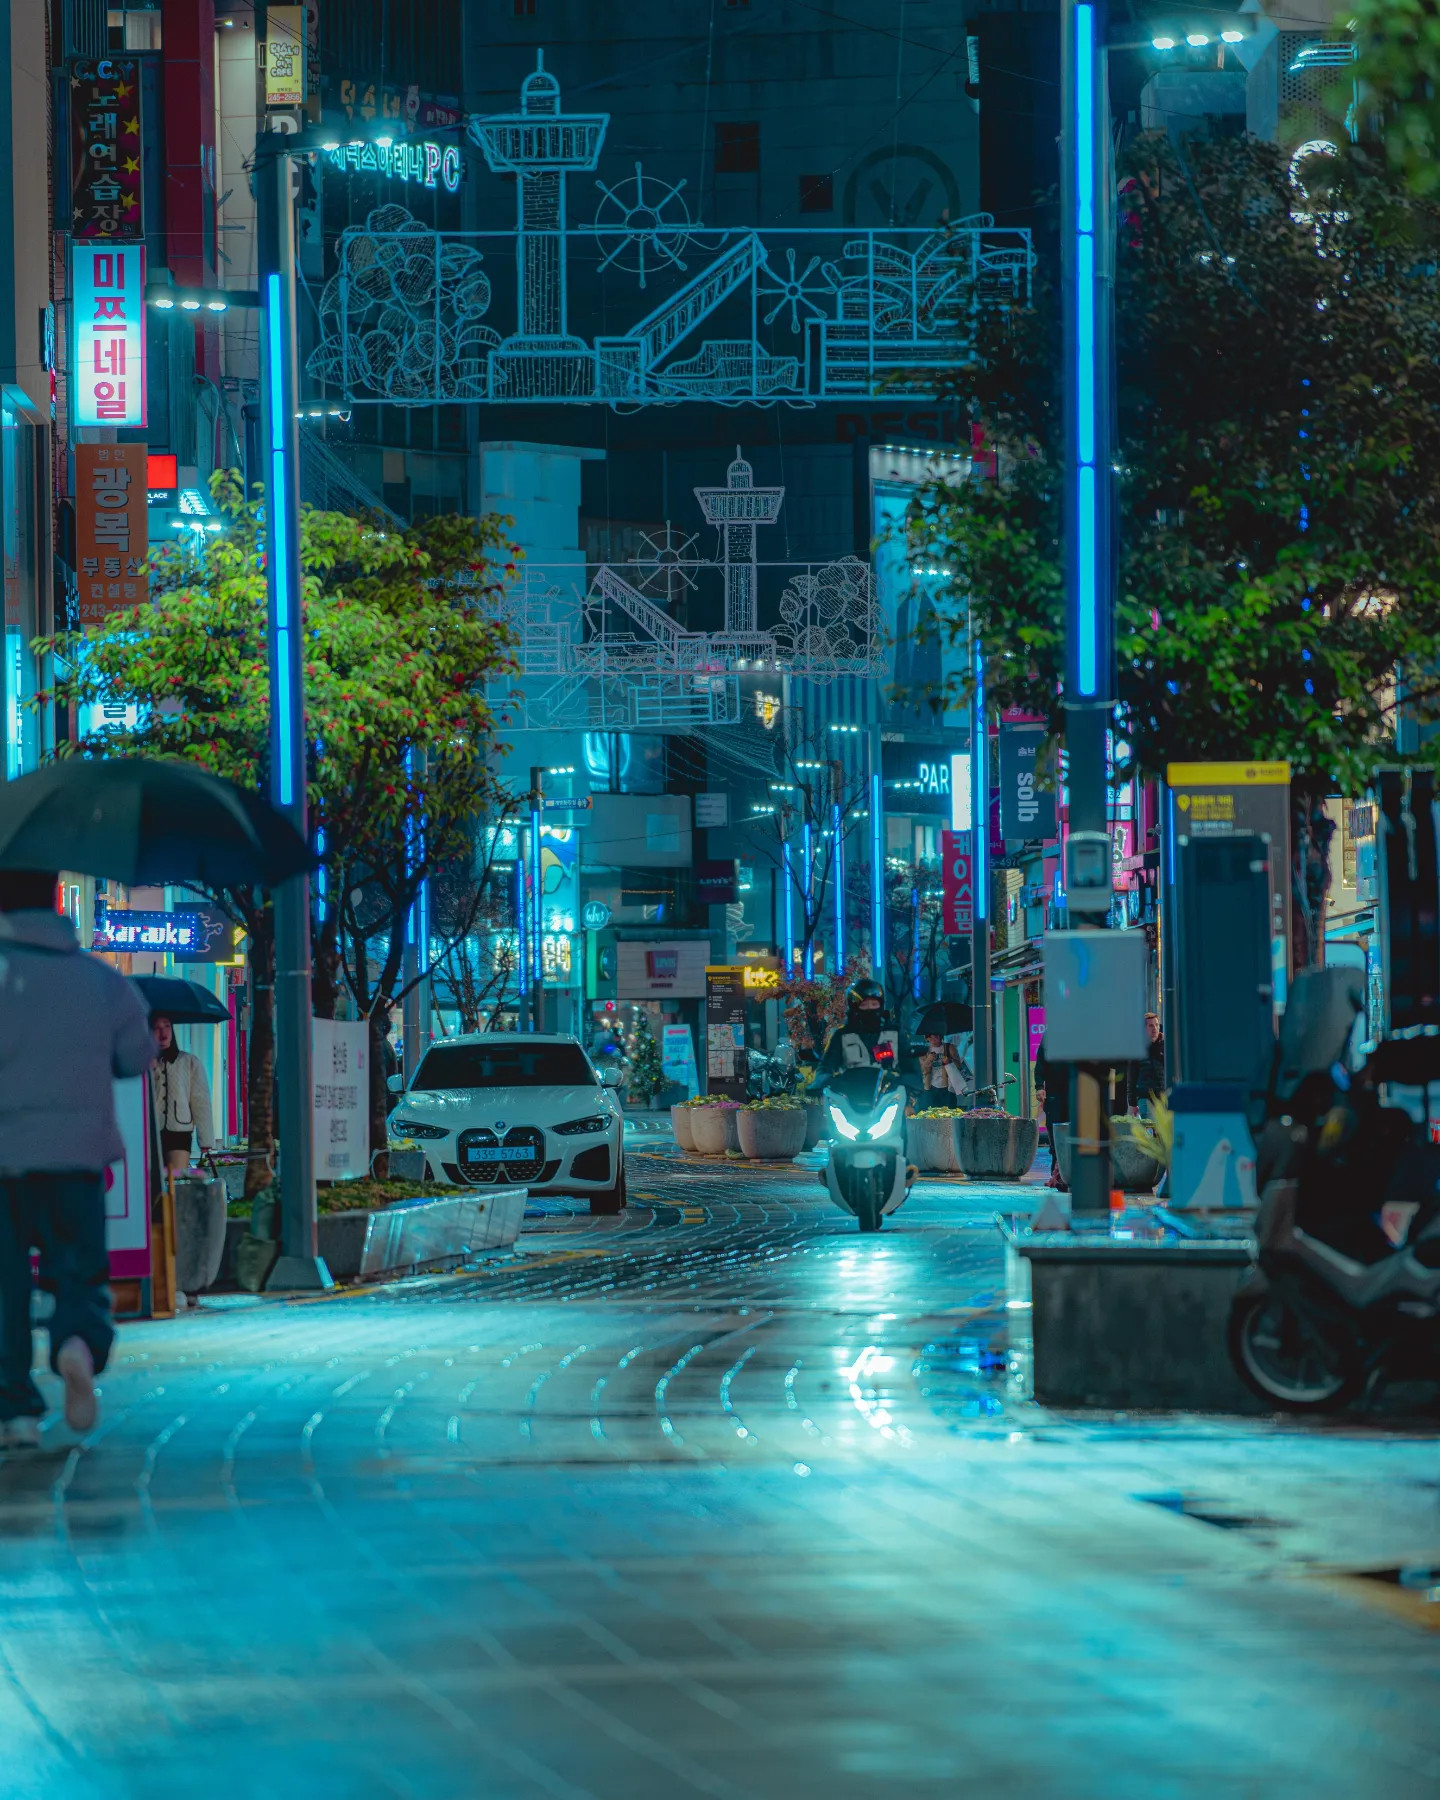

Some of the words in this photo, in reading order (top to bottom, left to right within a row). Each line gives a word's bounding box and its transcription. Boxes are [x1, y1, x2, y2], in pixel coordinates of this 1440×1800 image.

[271, 67, 293, 77] CAFE
[88, 87, 124, 232] 노래연습장
[93, 253, 127, 420] 미쯔네일
[82, 557, 143, 578] 부동산
[501, 1149, 529, 1159] 5763
